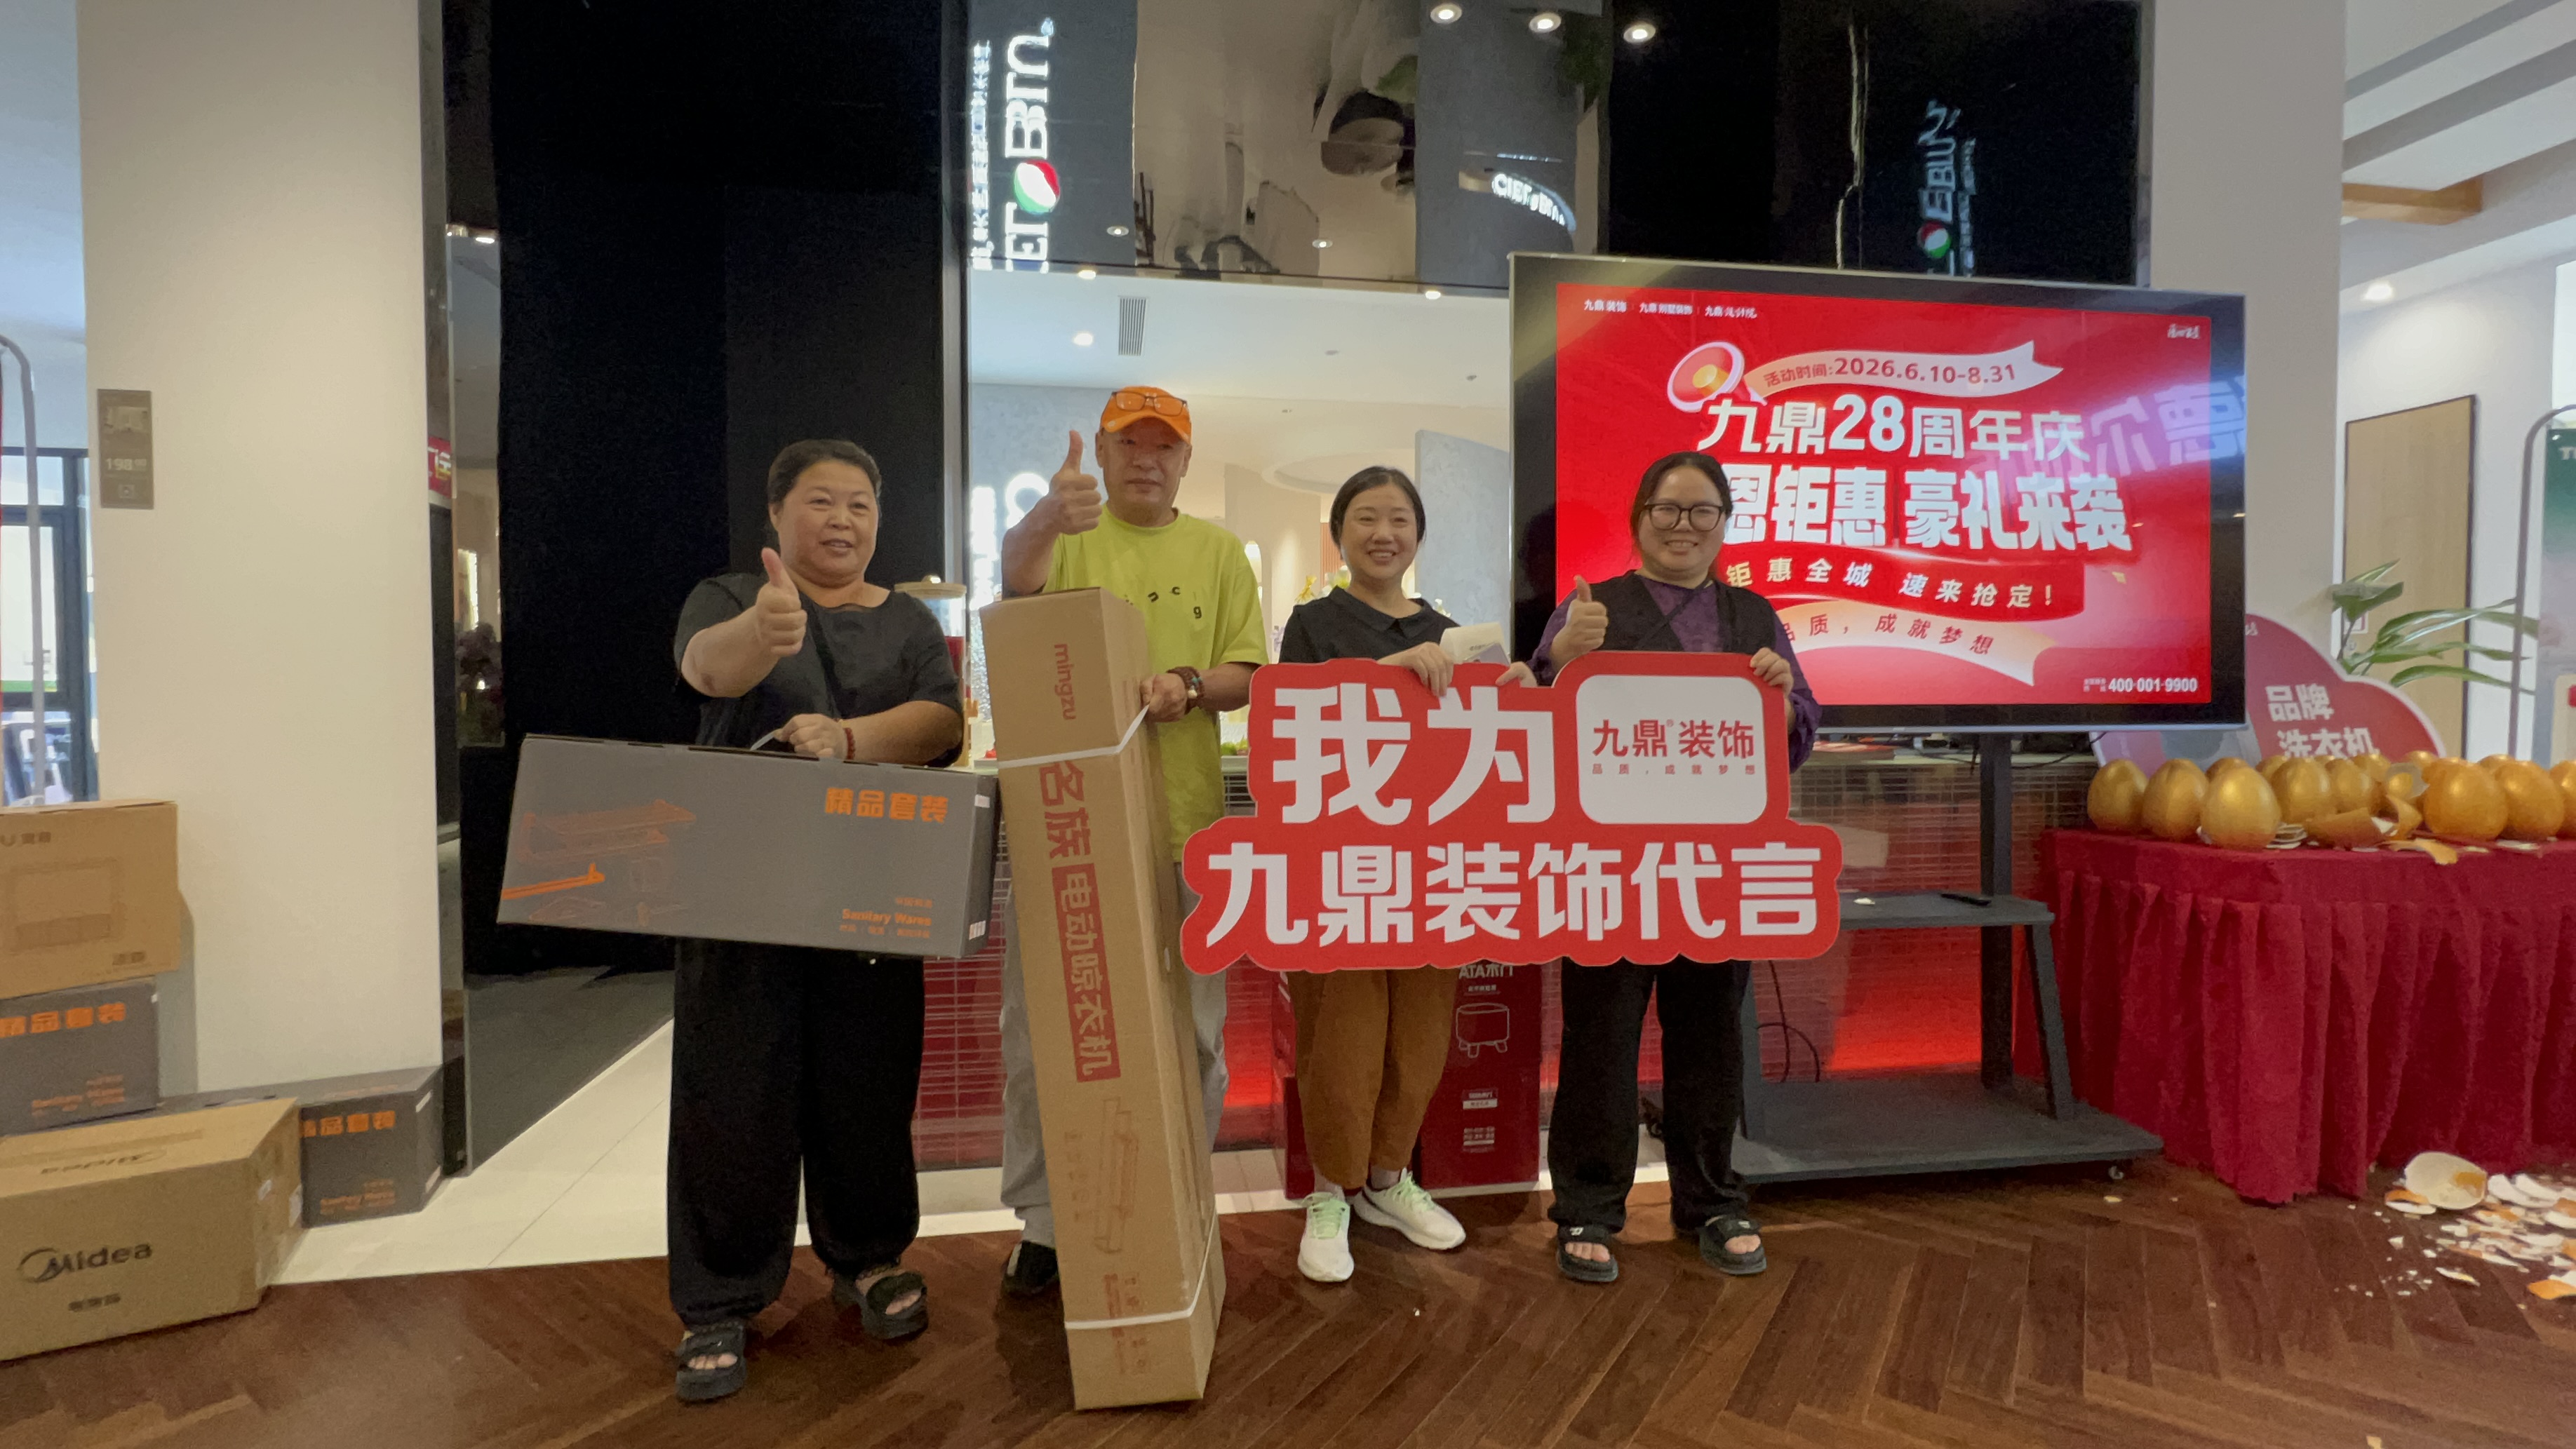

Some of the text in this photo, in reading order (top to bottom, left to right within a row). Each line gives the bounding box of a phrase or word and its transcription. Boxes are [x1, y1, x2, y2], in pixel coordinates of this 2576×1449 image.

[1696, 393, 2090, 462] 九鼎28周年庆
[1905, 469, 2133, 551] 豪礼来袭
[1726, 558, 1873, 588] 钜惠全城
[1054, 642, 1075, 720] mingzu
[2265, 683, 2335, 722] 品牌
[1273, 682, 1555, 826] 我为
[1207, 842, 1820, 948] 九鼎装饰代言
[18, 1242, 152, 1283] Midea
